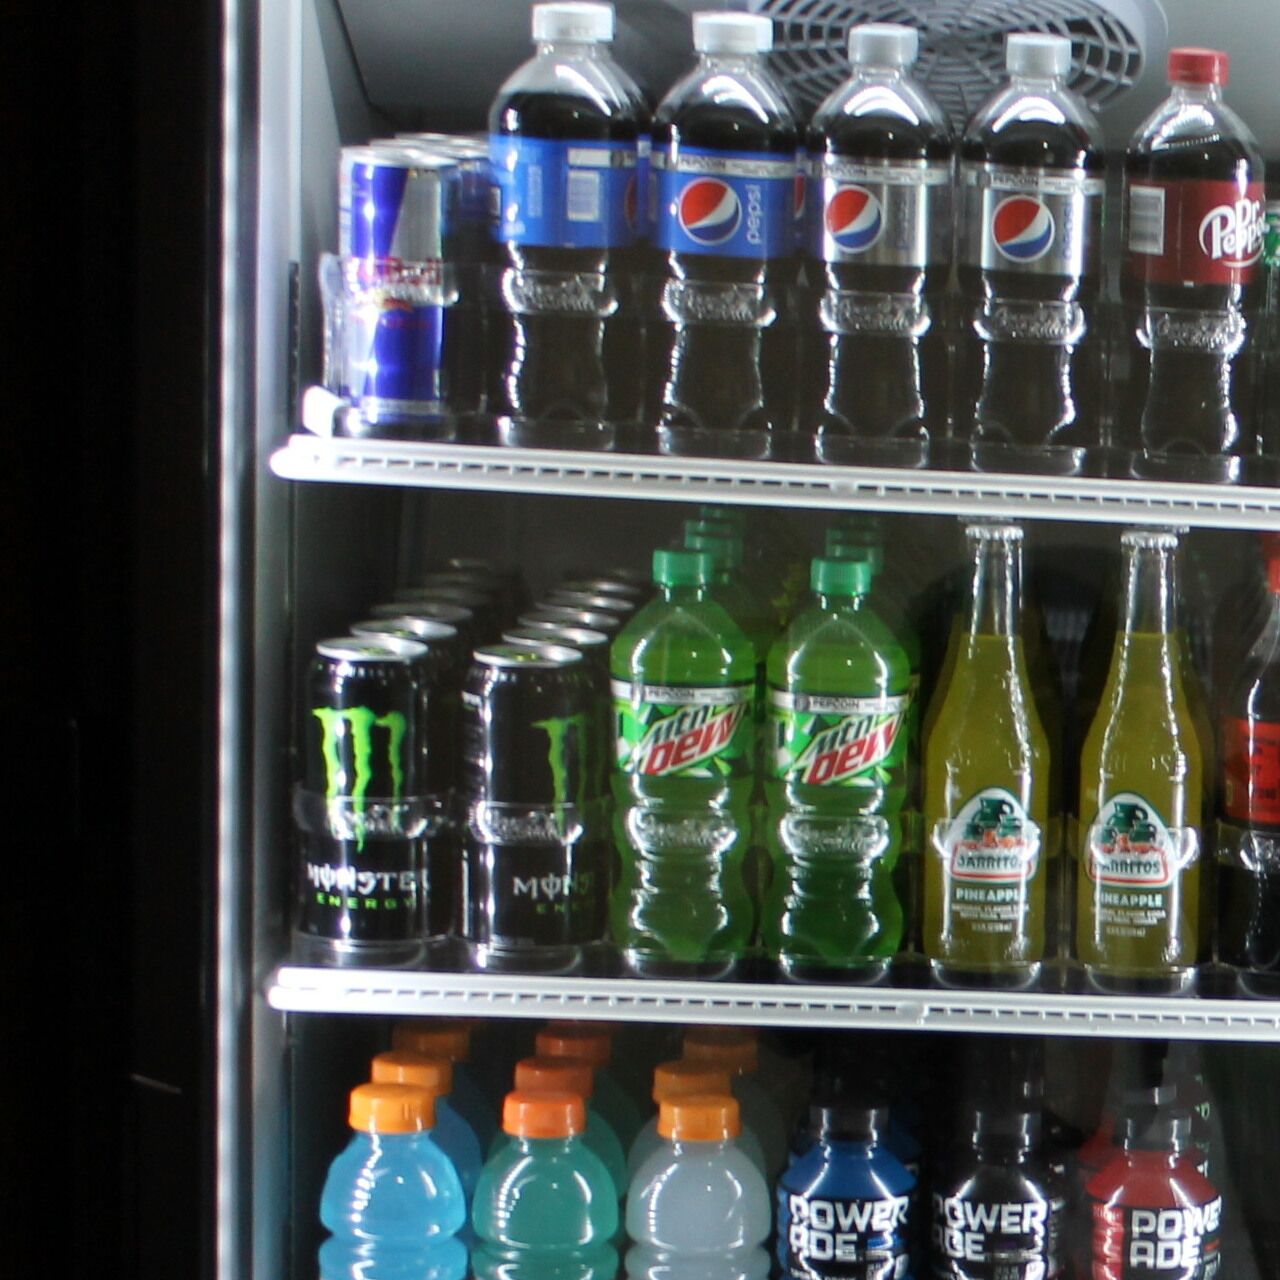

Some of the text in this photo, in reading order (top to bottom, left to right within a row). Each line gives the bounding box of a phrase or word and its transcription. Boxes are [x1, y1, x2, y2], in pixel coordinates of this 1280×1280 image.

[958, 854, 1022, 870] JARRITO
[956, 888, 1024, 900] PINEAPPL
[1097, 893, 1162, 908] INEAPPLE
[790, 1194, 909, 1232] POWER
[1132, 1195, 1222, 1241] POWE
[790, 1224, 857, 1262] ADE
[1130, 1236, 1201, 1269] ADE
